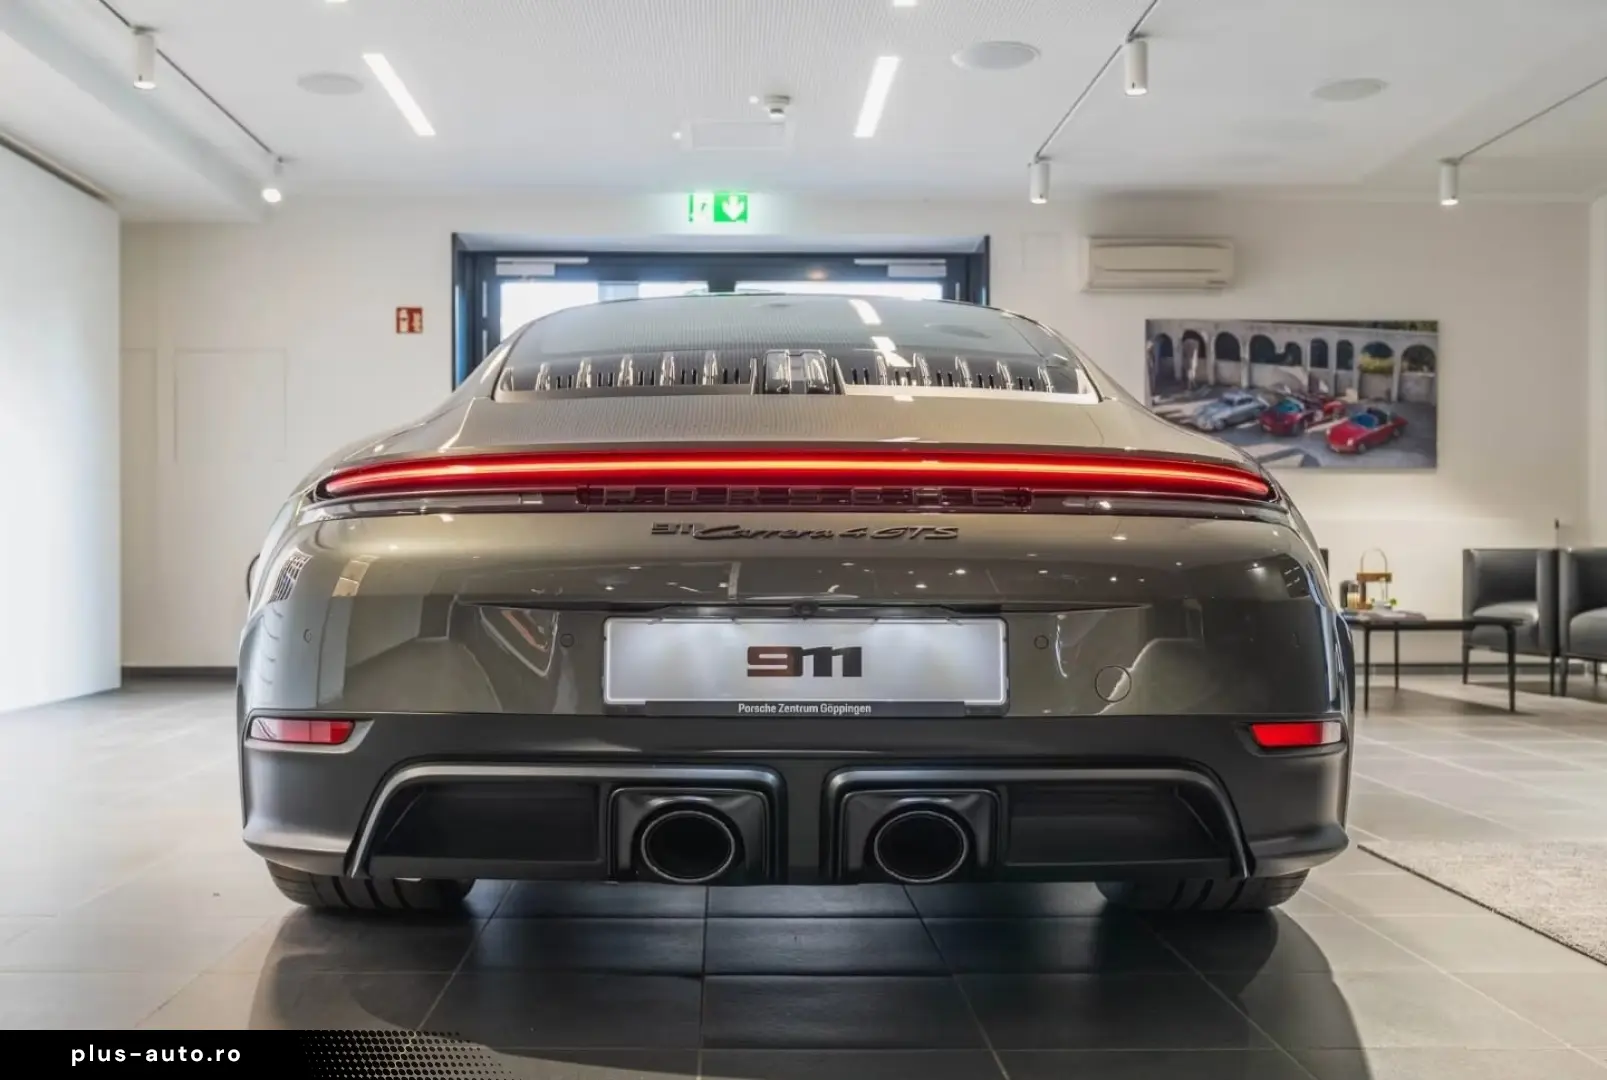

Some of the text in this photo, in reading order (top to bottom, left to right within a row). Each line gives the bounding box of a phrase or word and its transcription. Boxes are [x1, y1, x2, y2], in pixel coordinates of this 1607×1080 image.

[603, 486, 1005, 506] PORSCHE
[651, 521, 959, 540] 911 Carrera 4 GTS
[747, 646, 862, 677] 911
[738, 703, 872, 716] Porsche Zentrum Göppingen
